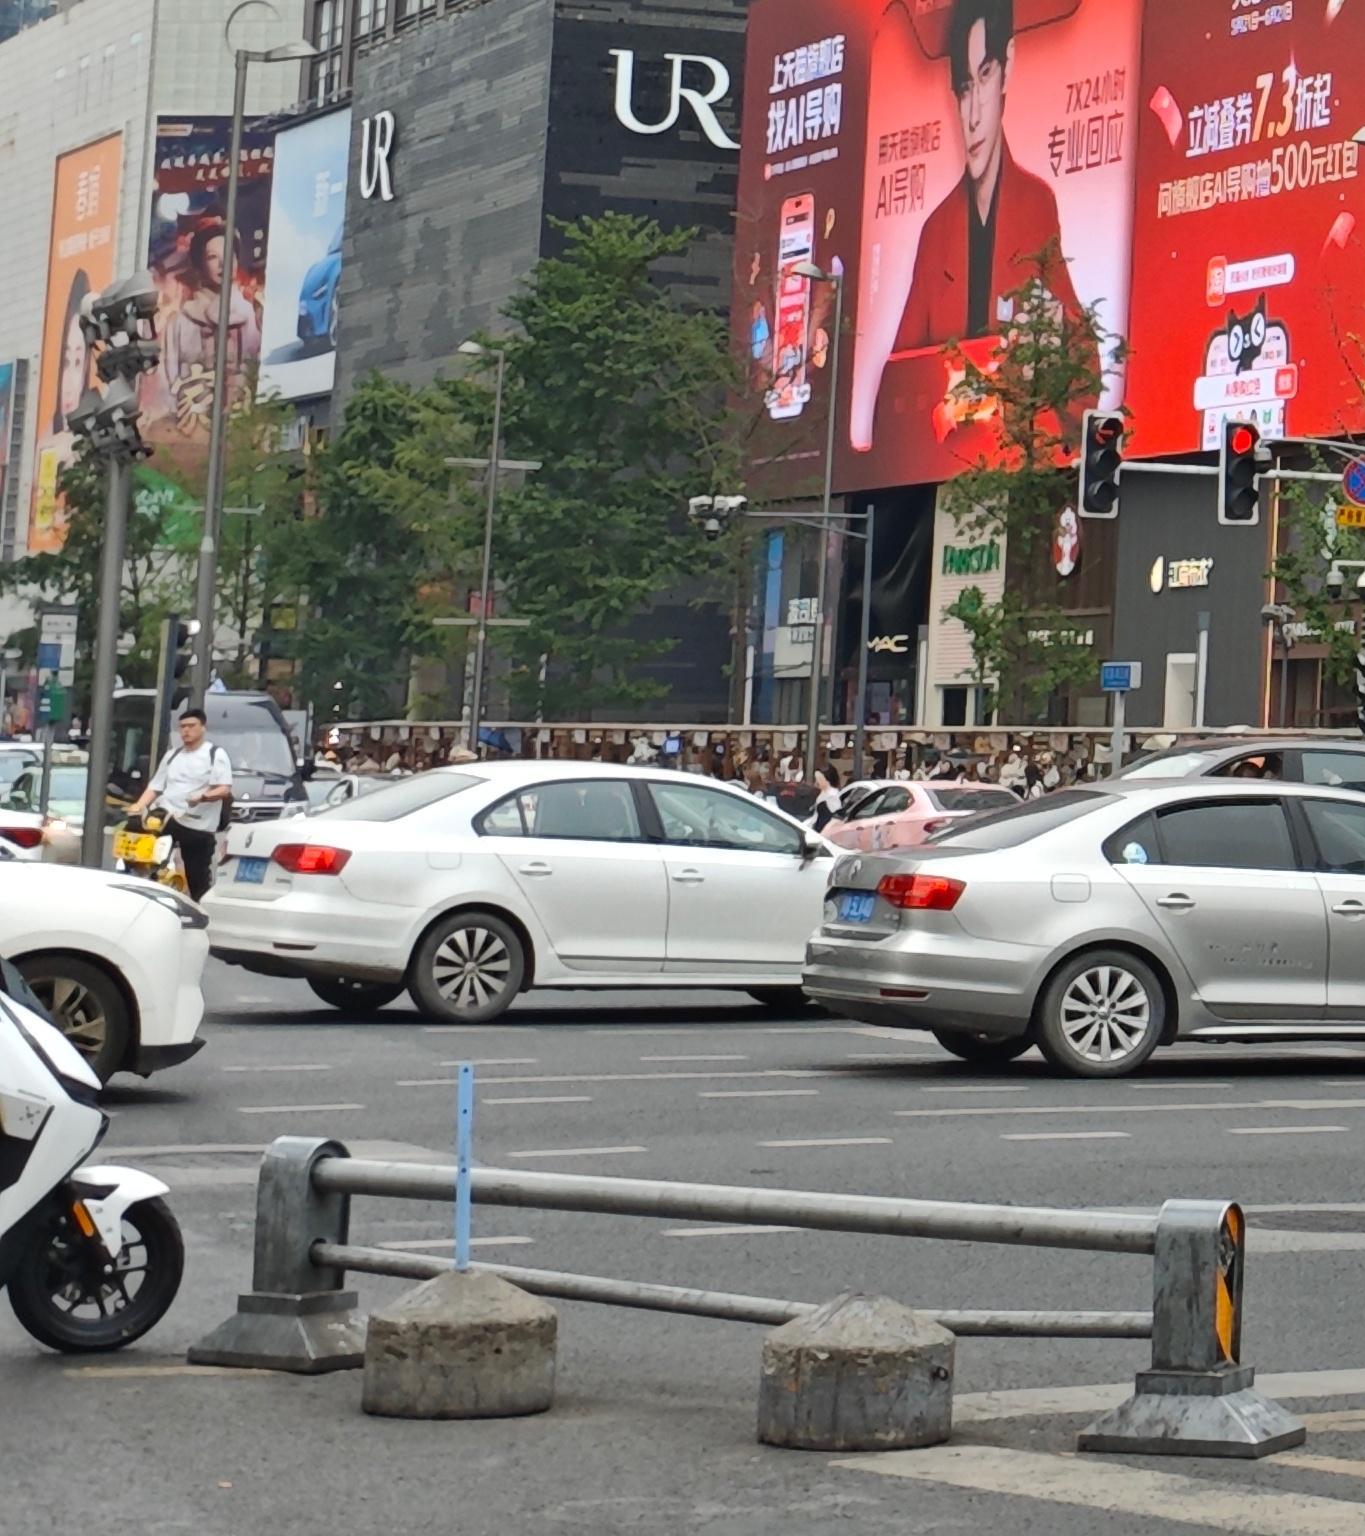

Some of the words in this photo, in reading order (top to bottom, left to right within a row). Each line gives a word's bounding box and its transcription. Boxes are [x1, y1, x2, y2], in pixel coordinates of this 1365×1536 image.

[608, 47, 741, 150] UR
[766, 82, 843, 155] 找AI导购
[360, 109, 395, 202] UR
[1047, 109, 1125, 178] 专业回应
[875, 163, 926, 219] AI导购
